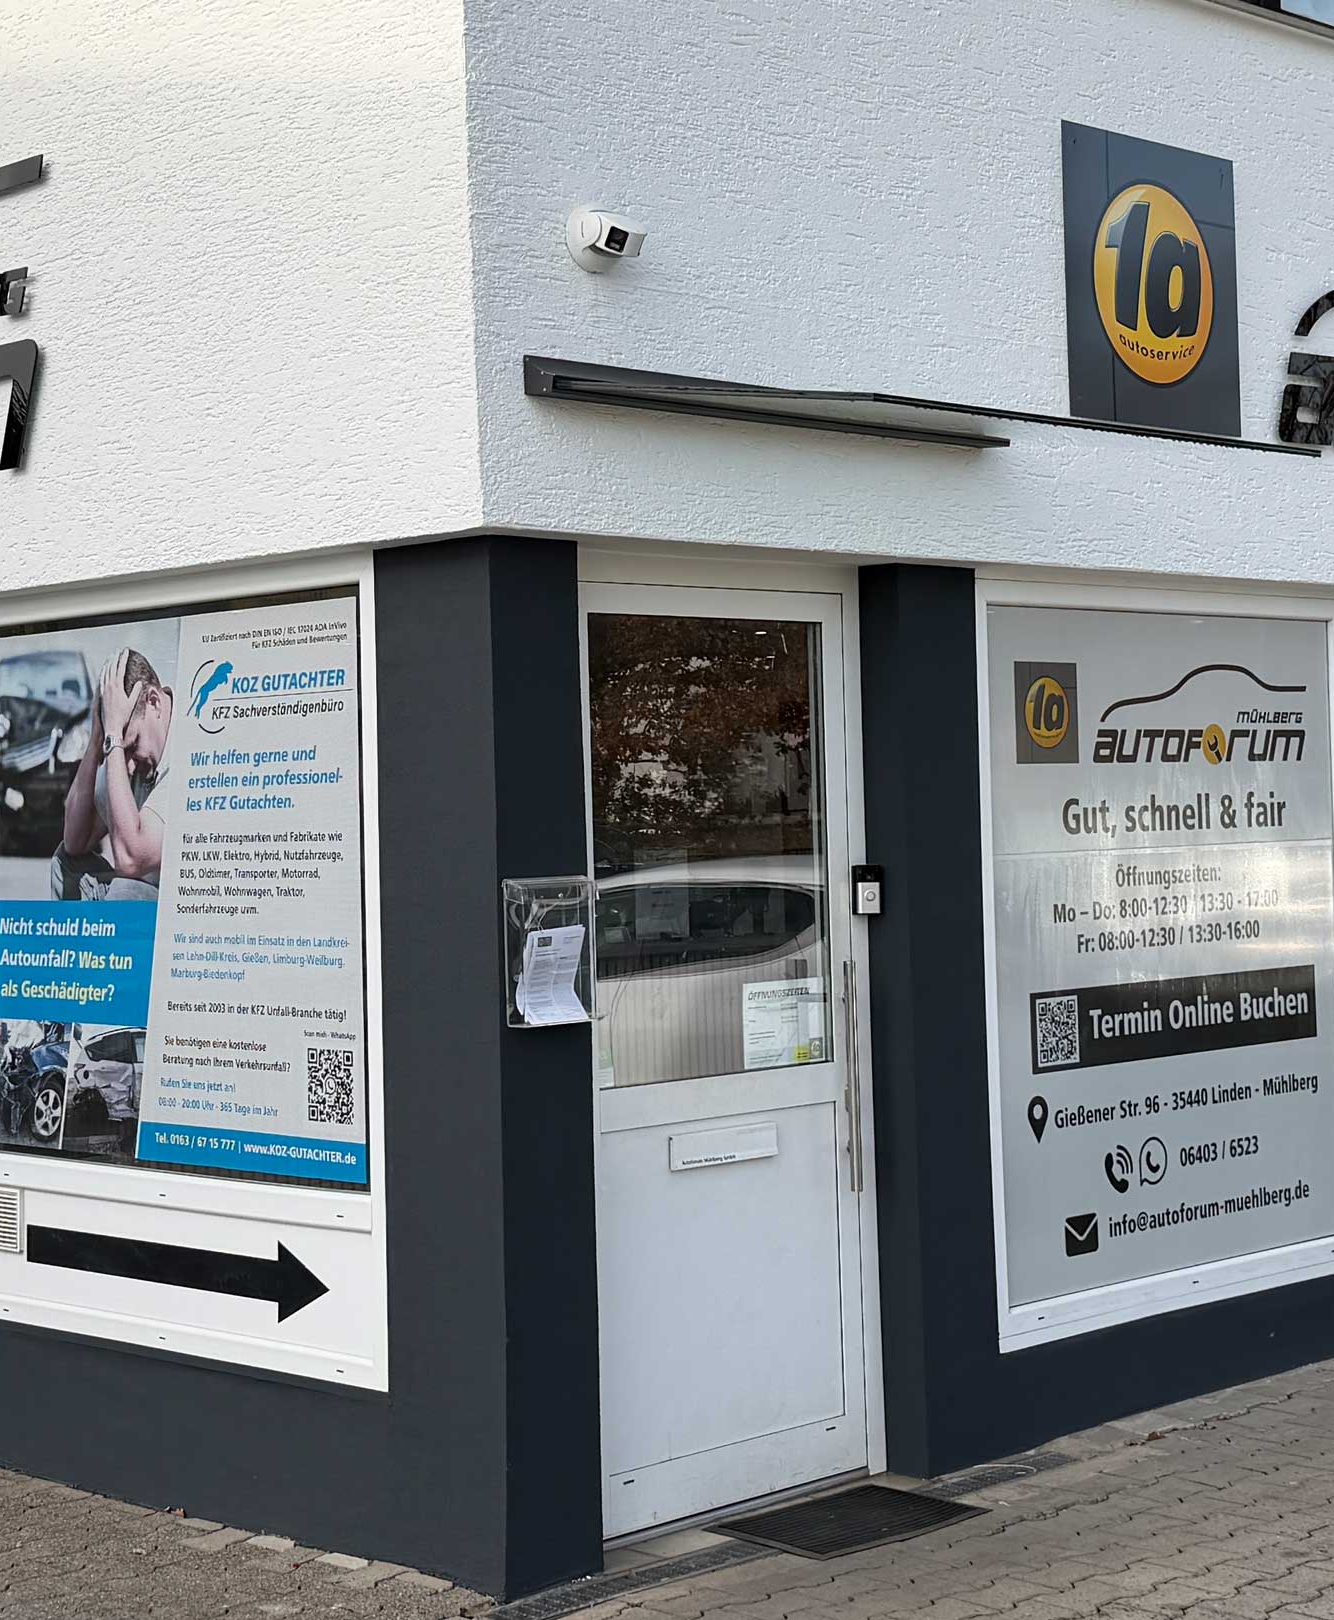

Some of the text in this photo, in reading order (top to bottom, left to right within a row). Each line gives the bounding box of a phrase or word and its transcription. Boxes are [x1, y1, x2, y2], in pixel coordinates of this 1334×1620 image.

[1119, 330, 1196, 363] autoservice
[232, 669, 345, 694] KOZ GUTACHTER
[212, 699, 344, 720] KFZ Sachverständigenbüro
[191, 745, 317, 767] Wir helfen gerne und
[189, 768, 343, 789] erstellen ein professionel-
[187, 795, 295, 811] les KFZ Gutachten.
[1062, 791, 1286, 838] Gut, schnell & fair
[183, 831, 342, 845] für alle Fahrzeugmarken und Fabrikate wie
[284, 850, 343, 862] Nutzfahrzeuge,
[1116, 864, 1221, 890] Öffnungszeiten:
[1053, 903, 1076, 924] Mo
[1093, 901, 1116, 920] Do:
[1120, 894, 1188, 917] 8:00-12:30
[1200, 892, 1233, 913] 13:30
[0, 918, 116, 937] Nicht schuld beim
[1077, 920, 1260, 954] Fr: 08:00-12:30 13:30-16:00
[0, 949, 133, 970] Autounfall? Was tun
[1, 980, 115, 1005] als Geschädigter?
[167, 1001, 192, 1012] Bereits
[194, 1002, 207, 1012] seit
[228, 1003, 235, 1014] in
[237, 1004, 249, 1015] der
[251, 1005, 265, 1015] KFZ
[267, 1006, 323, 1019] Unfall-Branche
[325, 1008, 346, 1022] tätig!
[1089, 987, 1308, 1039] Termin Online Buchen
[229, 1039, 266, 1051] kostenlose
[1055, 1073, 1318, 1129] Gießener Str. 96 35440 Linden Mühlberg
[155, 1132, 356, 1165] Tel. 0163 67 15 777 www.KOZ-GUTACHTER.de
[1180, 1136, 1259, 1167] 06403 6523
[1109, 1180, 1309, 1238] info@autoforum-muehlberg.de
